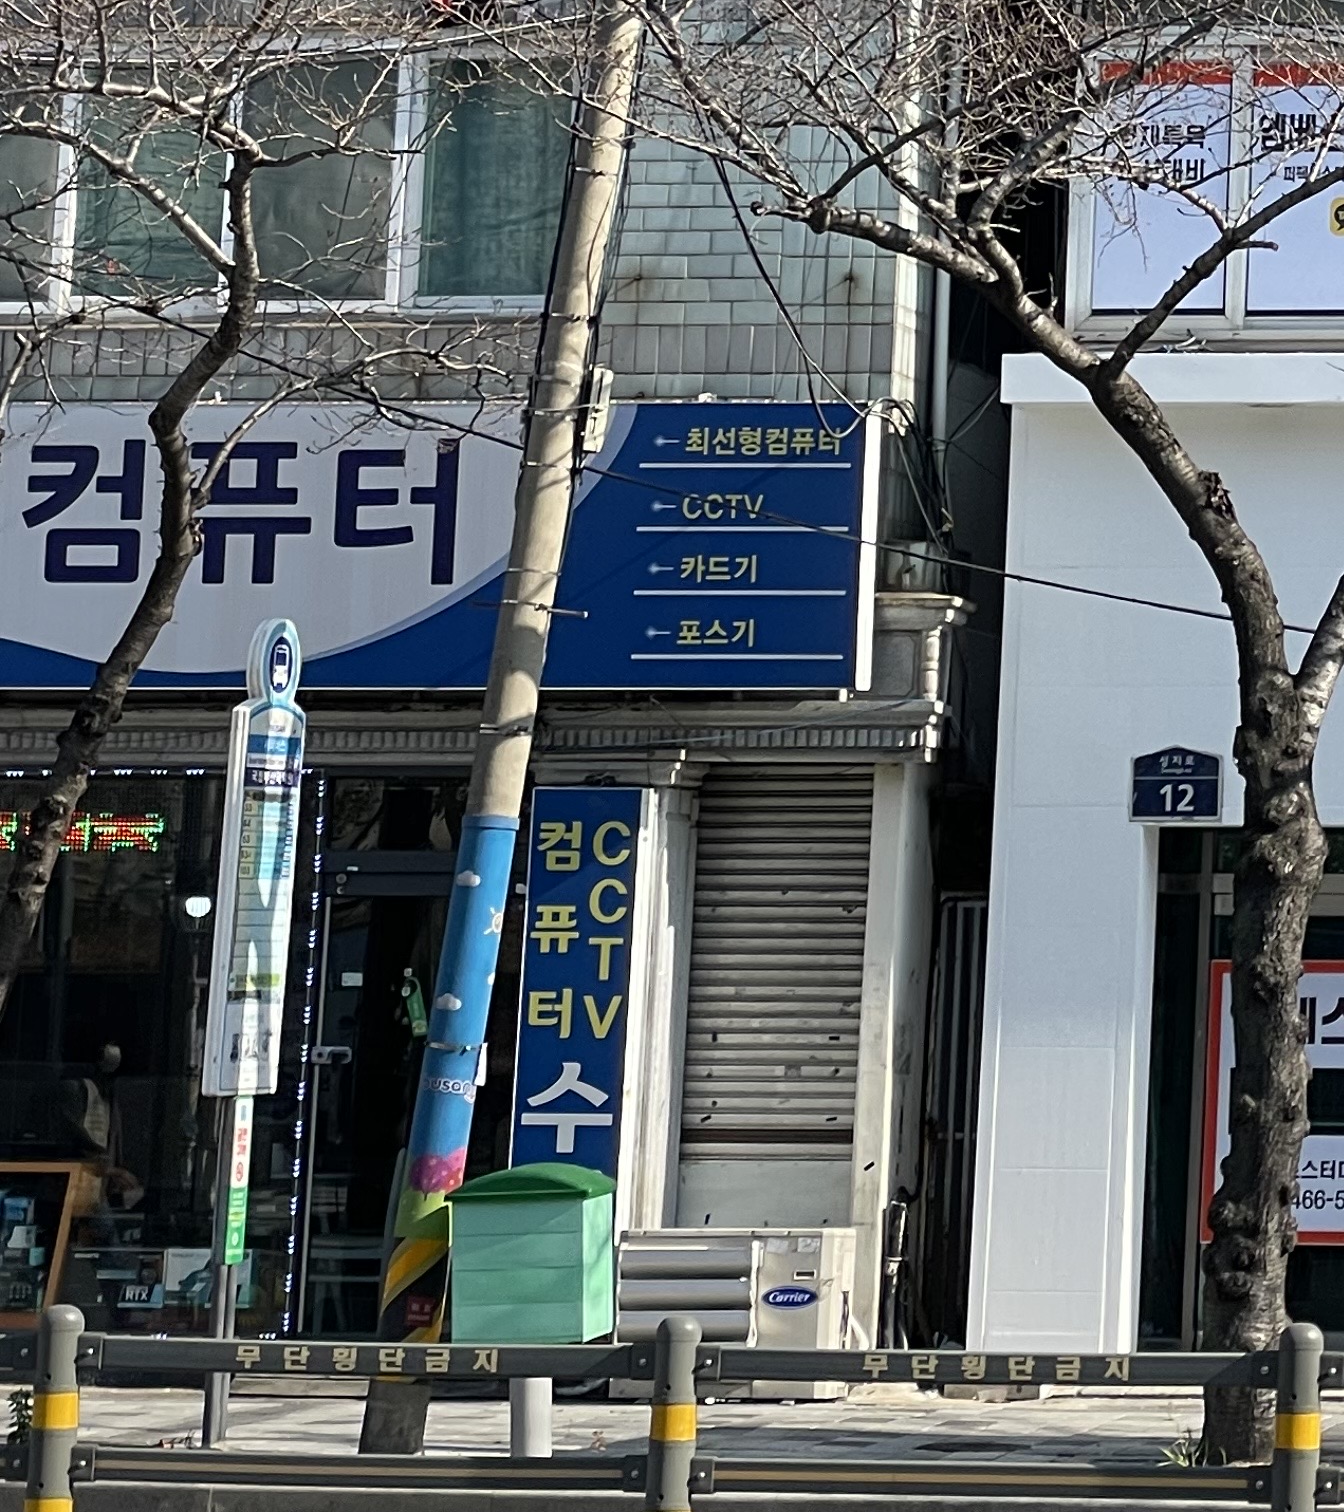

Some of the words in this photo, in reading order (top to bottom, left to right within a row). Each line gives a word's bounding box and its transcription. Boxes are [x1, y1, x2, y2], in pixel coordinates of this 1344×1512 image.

[685, 427, 842, 456] 최선형컴퓨터
[22, 437, 459, 585] 컴퓨터
[682, 494, 764, 520] CCTV
[680, 554, 760, 585] 카드기
[676, 619, 757, 649] 포스기
[1159, 783, 1195, 813] 12
[528, 821, 582, 1040] 컴퓨터
[583, 819, 632, 1041] CCTV
[769, 1291, 811, 1303] Carrier
[235, 1344, 501, 1375] 무단횡단금지
[861, 1351, 1132, 1382] 무단횡단금지
